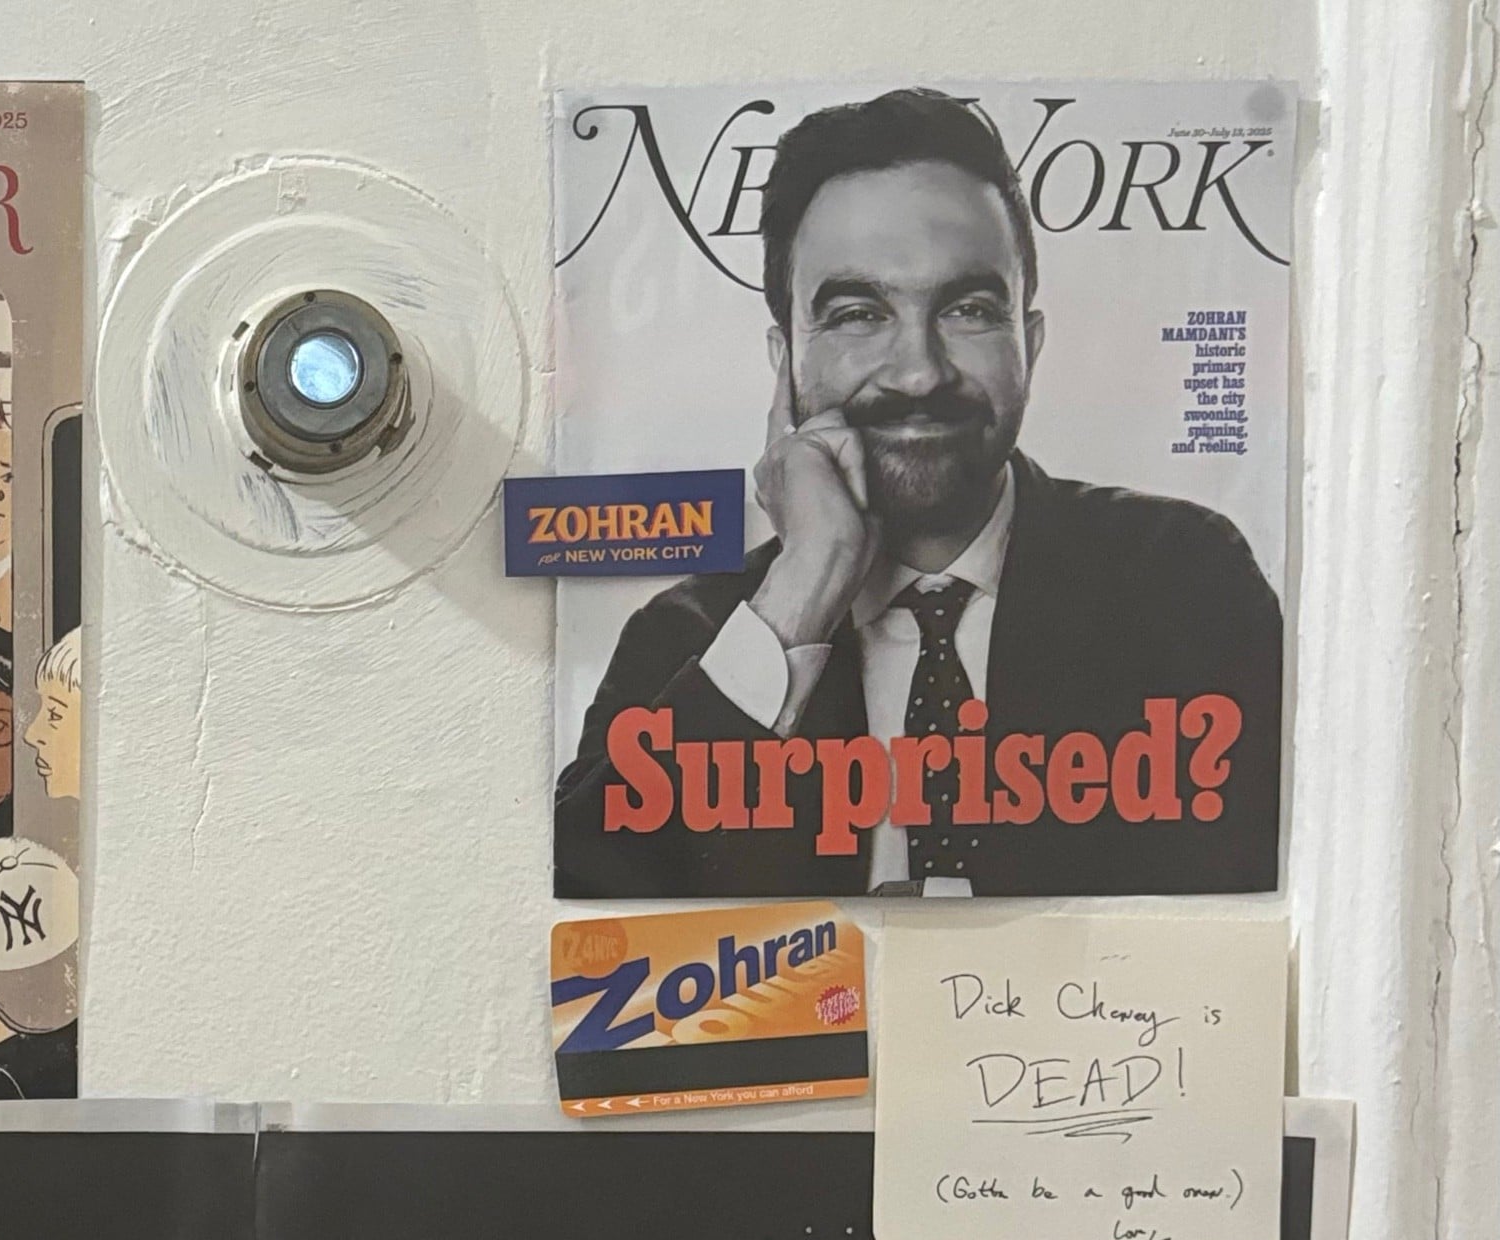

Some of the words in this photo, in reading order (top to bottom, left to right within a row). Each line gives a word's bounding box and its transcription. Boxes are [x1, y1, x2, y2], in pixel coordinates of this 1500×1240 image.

[1187, 310, 1247, 326] ZOHRAN
[1161, 326, 1247, 342] MAMDANI'S
[1195, 342, 1246, 358] historic
[1192, 360, 1246, 376] primary
[1184, 376, 1219, 392] upset
[1222, 375, 1245, 389] has
[1197, 391, 1218, 405] the
[1221, 390, 1245, 407] city
[1184, 407, 1248, 423] swooning,
[1187, 423, 1248, 440] spinning,
[1171, 440, 1195, 453] and
[527, 500, 714, 545] ZOHRAN
[565, 549, 608, 563] NEW
[609, 546, 658, 561] YORK
[662, 544, 704, 559] CITY
[603, 693, 1244, 857] Surprised?
[550, 919, 837, 1053] Zohran
[940, 973, 1026, 1020] Dick
[1203, 1004, 1222, 1026] is
[965, 1046, 1187, 1108] DEAD!
[653, 1095, 671, 1107] For
[674, 1097, 681, 1105] a
[684, 1093, 707, 1104] New
[710, 1091, 734, 1102] York
[737, 1089, 757, 1102] you
[759, 1088, 779, 1098] can
[782, 1085, 814, 1096] afford
[936, 1174, 1009, 1203] (Gotta
[1031, 1176, 1058, 1200] be
[1084, 1186, 1104, 1198] a
[1120, 1173, 1168, 1210] good
